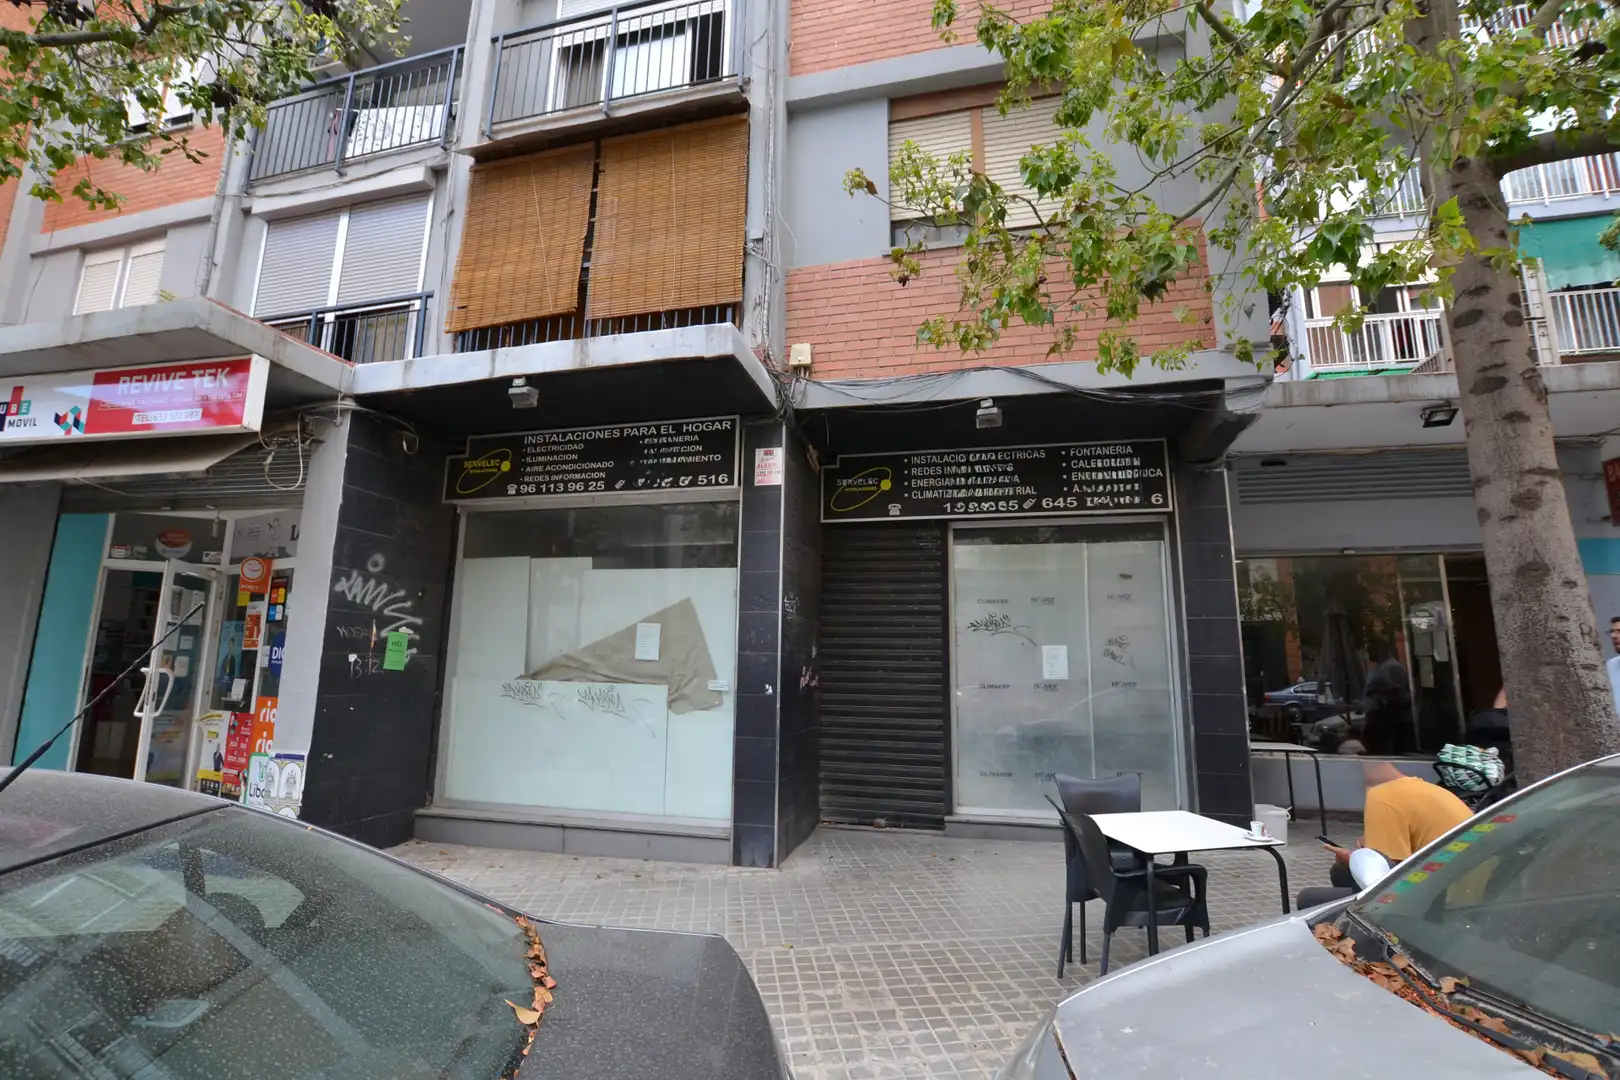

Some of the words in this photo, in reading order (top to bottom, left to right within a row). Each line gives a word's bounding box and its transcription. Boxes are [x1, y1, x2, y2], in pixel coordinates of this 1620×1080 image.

[117, 371, 187, 396] REVIVE
[191, 366, 231, 389] TEK
[524, 429, 621, 445] INSTALACIONES
[623, 426, 657, 437] PARA
[660, 424, 677, 435] EL
[683, 420, 732, 433] HOGAR
[526, 443, 584, 453] ELECTRICIDAD
[1070, 445, 1134, 457] FONTANERIA
[526, 453, 578, 463] ILUMINACION
[525, 464, 545, 473] AIRE
[545, 460, 614, 472] ACONDICIONADO
[911, 467, 942, 476] REDES
[524, 474, 550, 483] REDES
[550, 471, 606, 481] INFORMACION
[697, 473, 729, 486] 516
[519, 483, 537, 494] 96
[540, 482, 565, 493] 113
[567, 481, 585, 492] 96
[587, 480, 606, 491] 25
[1041, 496, 1078, 509] 645
